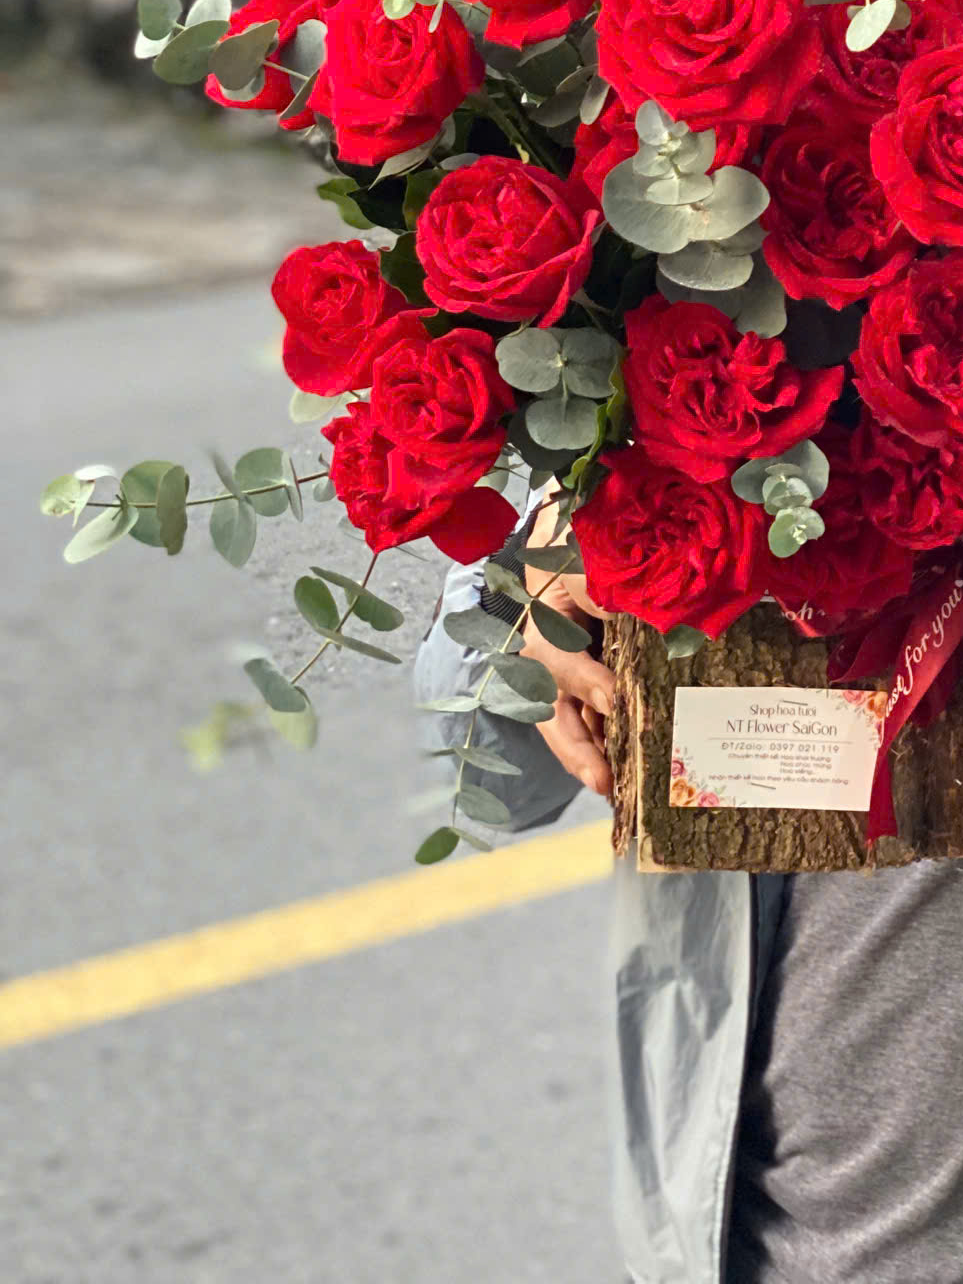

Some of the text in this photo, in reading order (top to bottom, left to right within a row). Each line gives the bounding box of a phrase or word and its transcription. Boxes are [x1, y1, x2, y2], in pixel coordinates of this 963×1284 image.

[902, 631, 932, 696] for
[930, 587, 963, 649] you
[749, 703, 776, 718] Shop
[726, 719, 838, 736] NT Flower SaiGon
